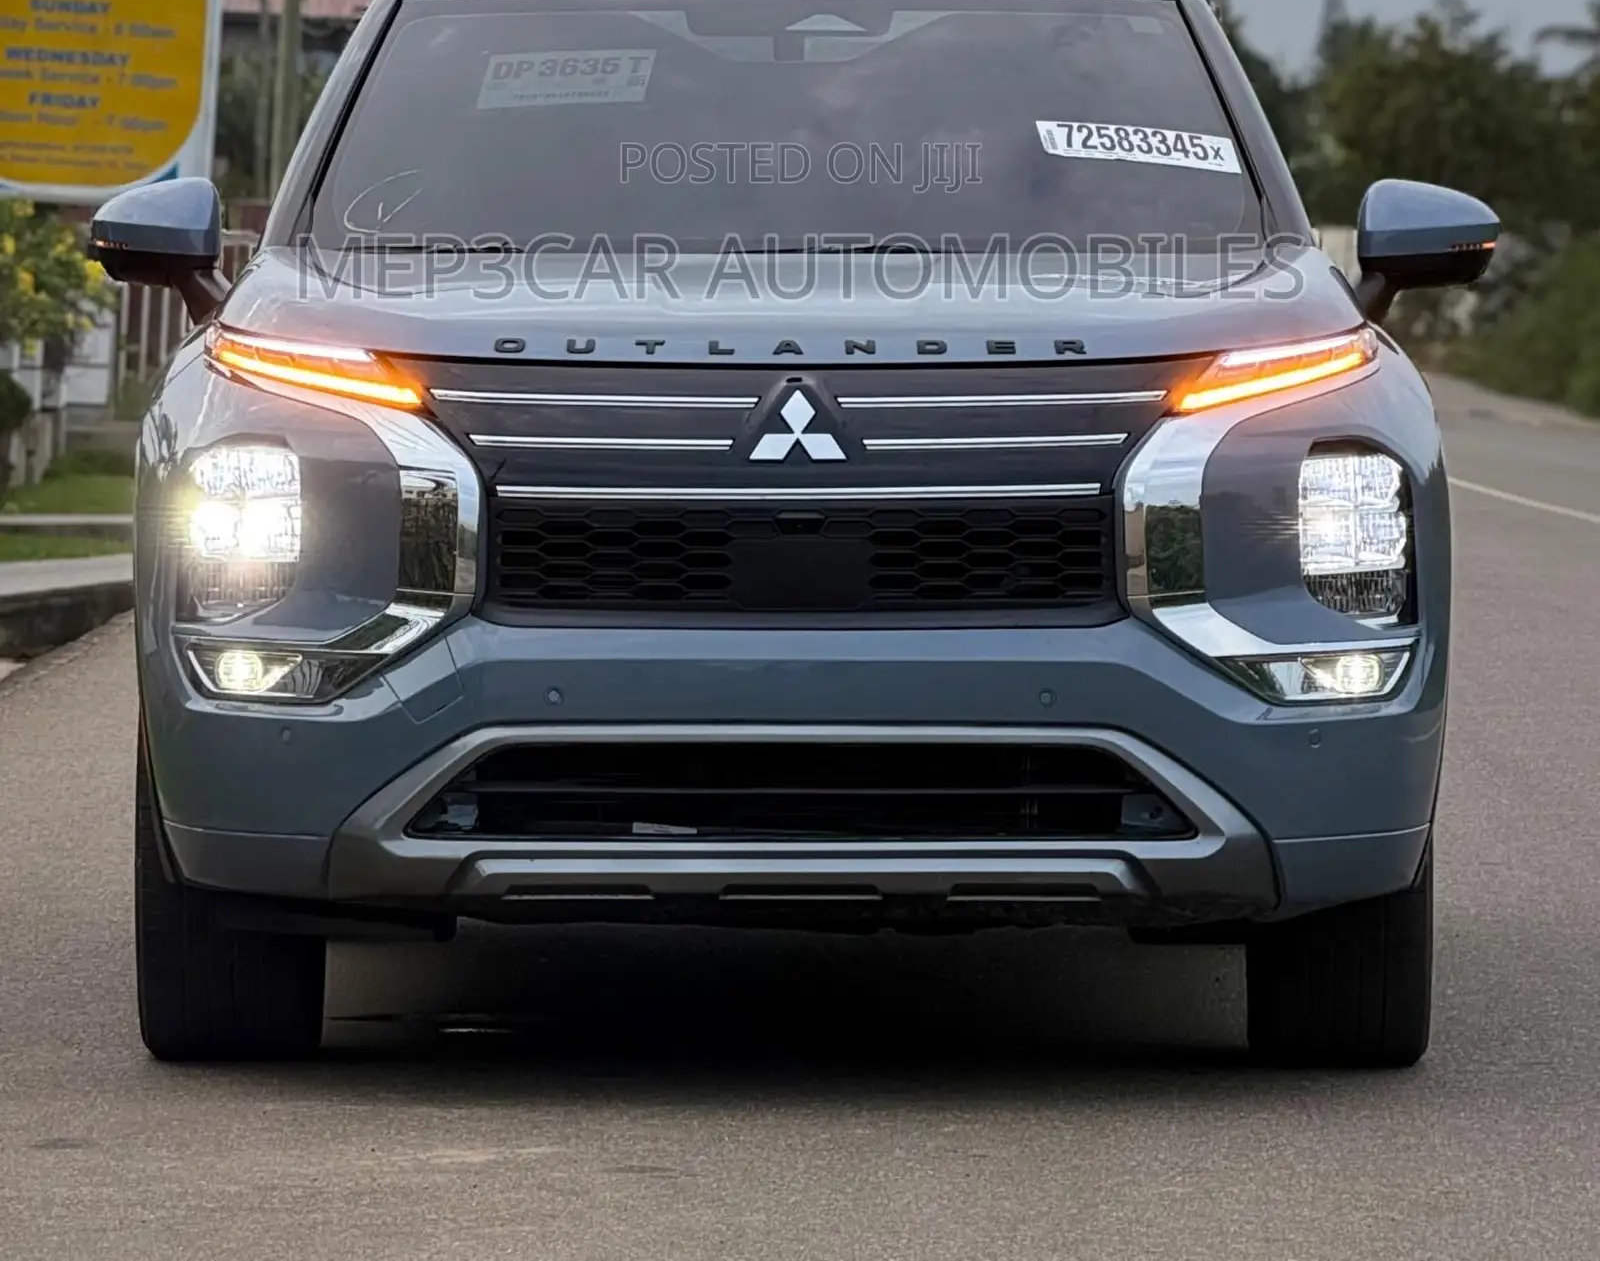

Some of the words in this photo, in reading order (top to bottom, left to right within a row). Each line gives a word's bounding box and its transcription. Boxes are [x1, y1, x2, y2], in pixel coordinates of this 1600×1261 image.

[6, 47, 130, 67] WEDNESDAY
[491, 60, 535, 80] DP
[29, 92, 100, 109] FRIDAY
[494, 337, 1087, 356] OUTLANDER
